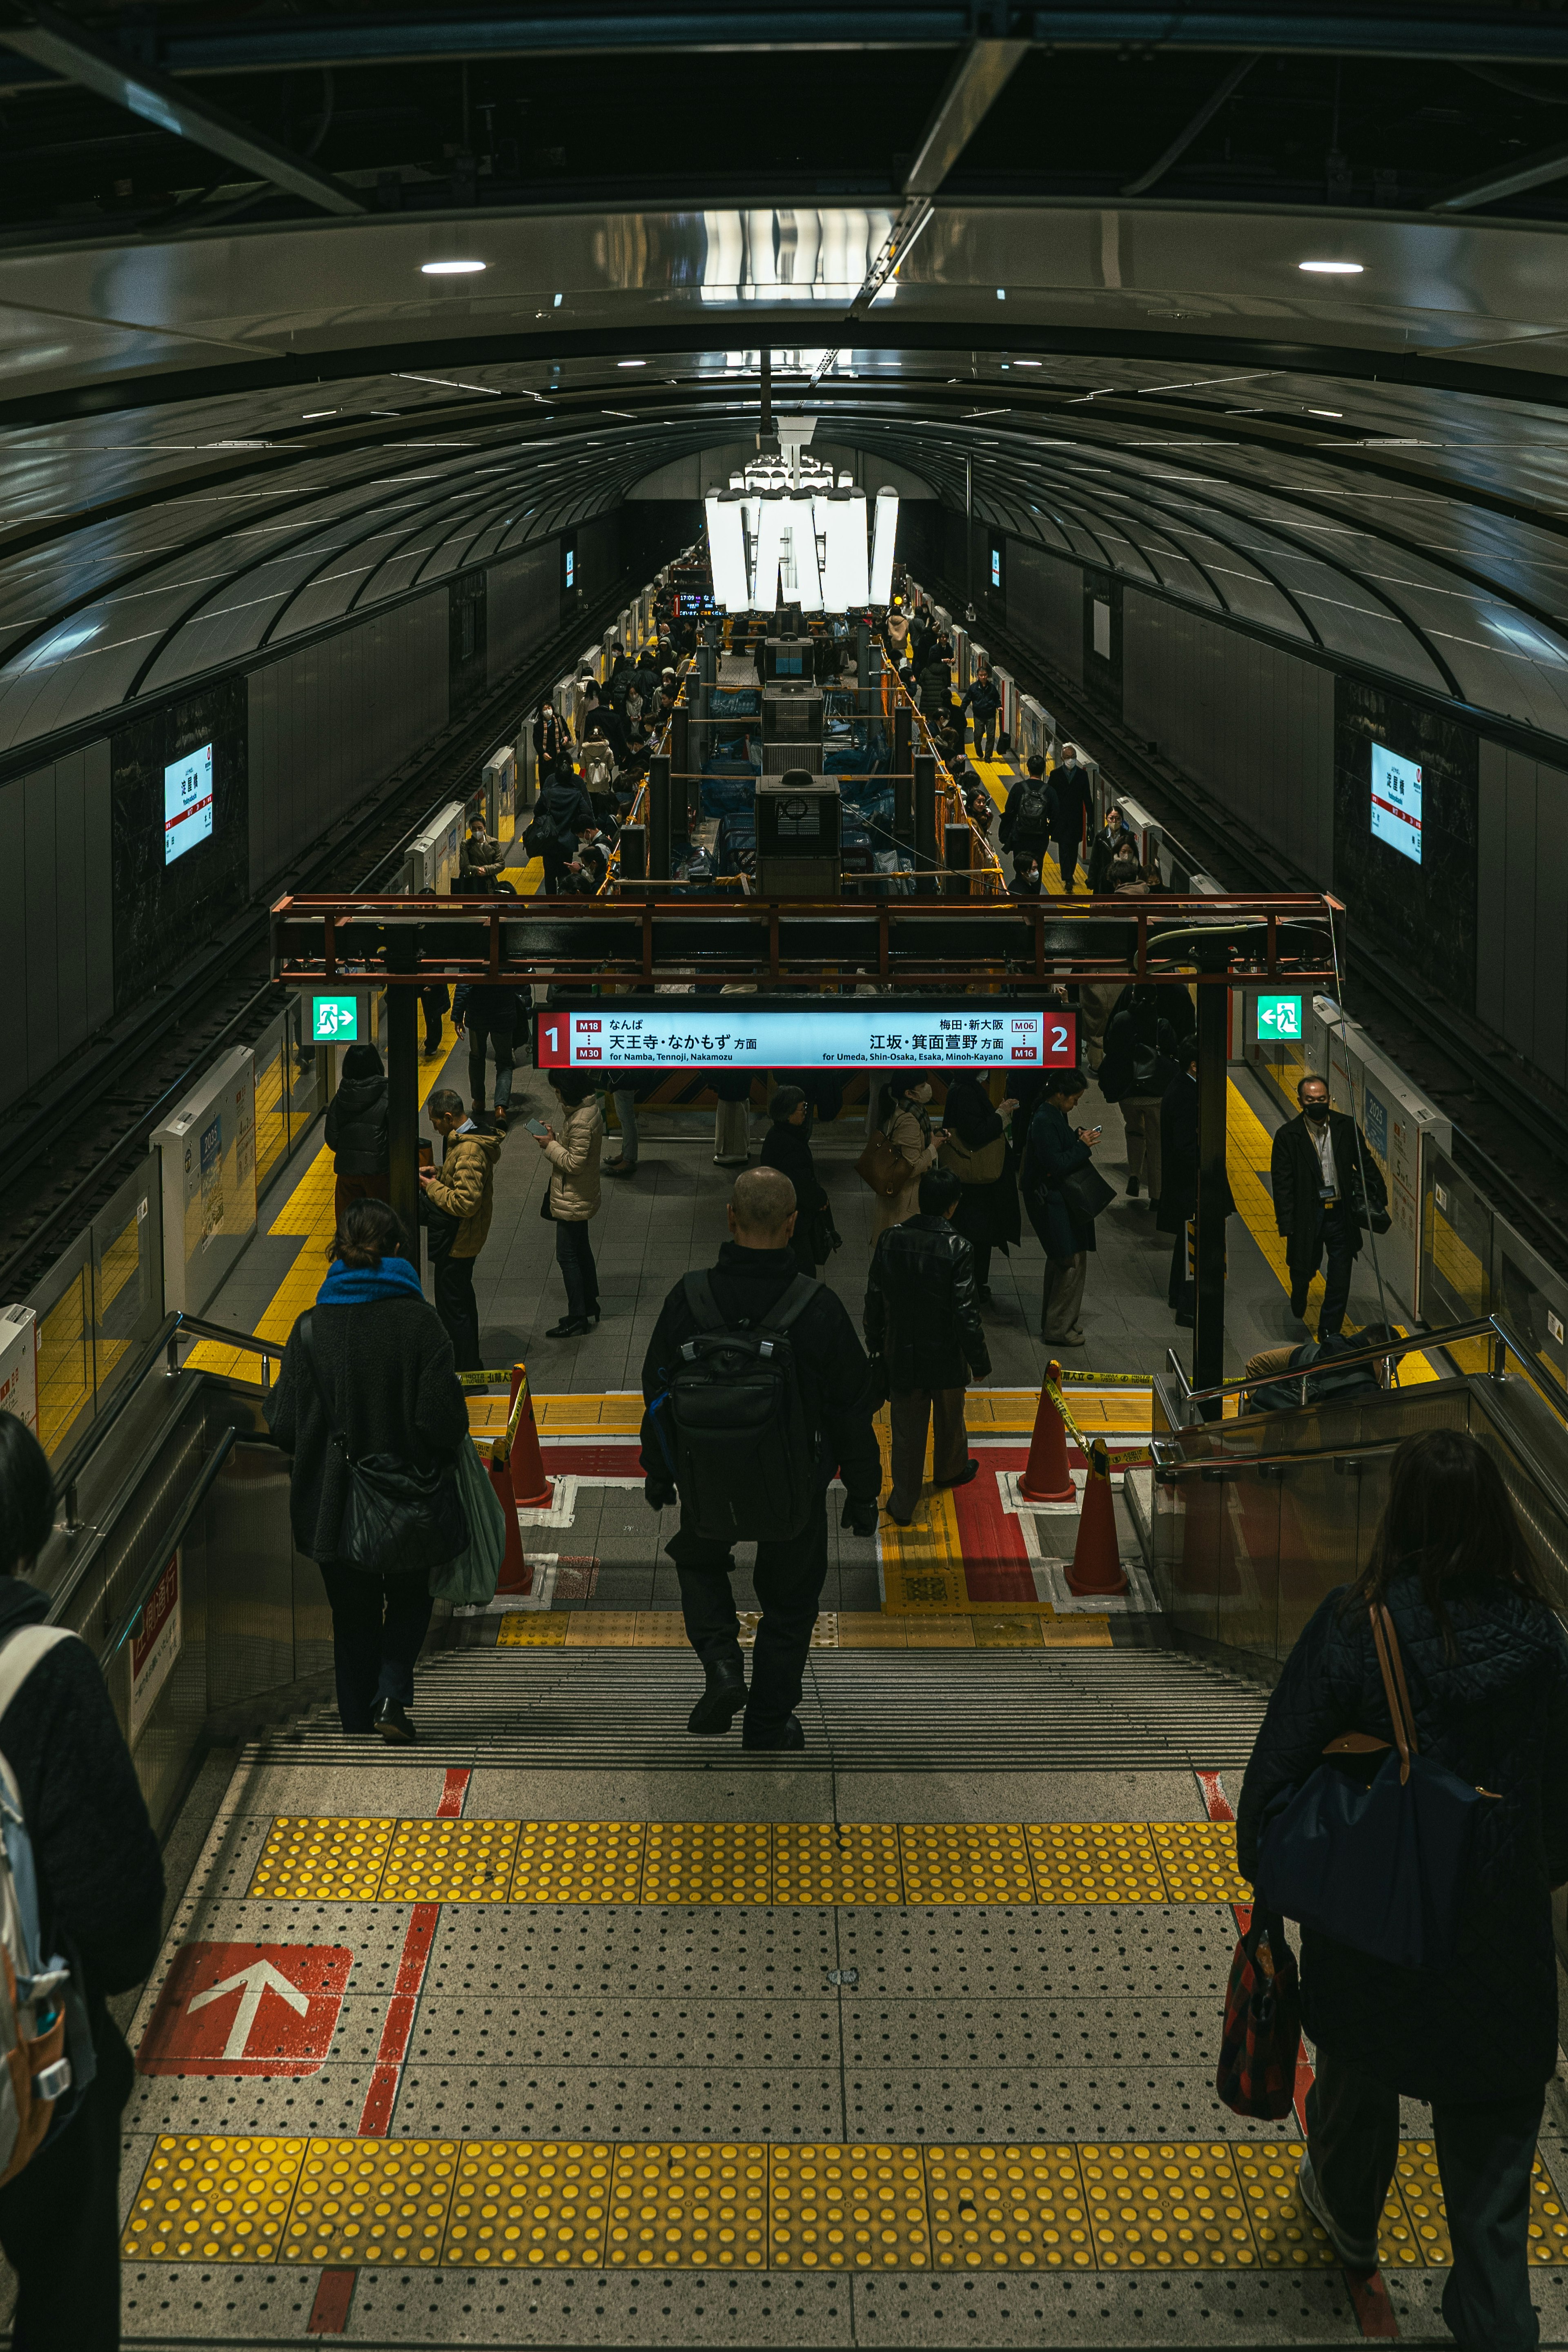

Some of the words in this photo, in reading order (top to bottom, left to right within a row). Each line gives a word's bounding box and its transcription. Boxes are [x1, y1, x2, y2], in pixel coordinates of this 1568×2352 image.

[675, 597, 678, 615] 1
[181, 773, 198, 796] 淀屋橋
[183, 792, 197, 806] Yodoyabashi
[610, 1019, 643, 1030] なんば
[940, 1019, 1003, 1030] 梅田・新大阪
[545, 1027, 558, 1052] 1
[610, 1034, 731, 1049] 天王寺・なかもず
[735, 1038, 757, 1049] 方面
[870, 1034, 977, 1049] 江坂・箕面萱野
[981, 1038, 1003, 1049] 方面
[1051, 1027, 1068, 1051] 2
[657, 1053, 688, 1062] Tennoji,
[837, 1053, 867, 1061] Umeda,
[870, 1053, 916, 1061] Shin-Osaka,
[919, 1053, 943, 1061] Esaka,
[946, 1053, 1003, 1062] Minoh-Kayano
[1015, 1049, 1033, 1058] M16
[1370, 1099, 1383, 1125] 2025
[205, 1125, 217, 1154] 2035
